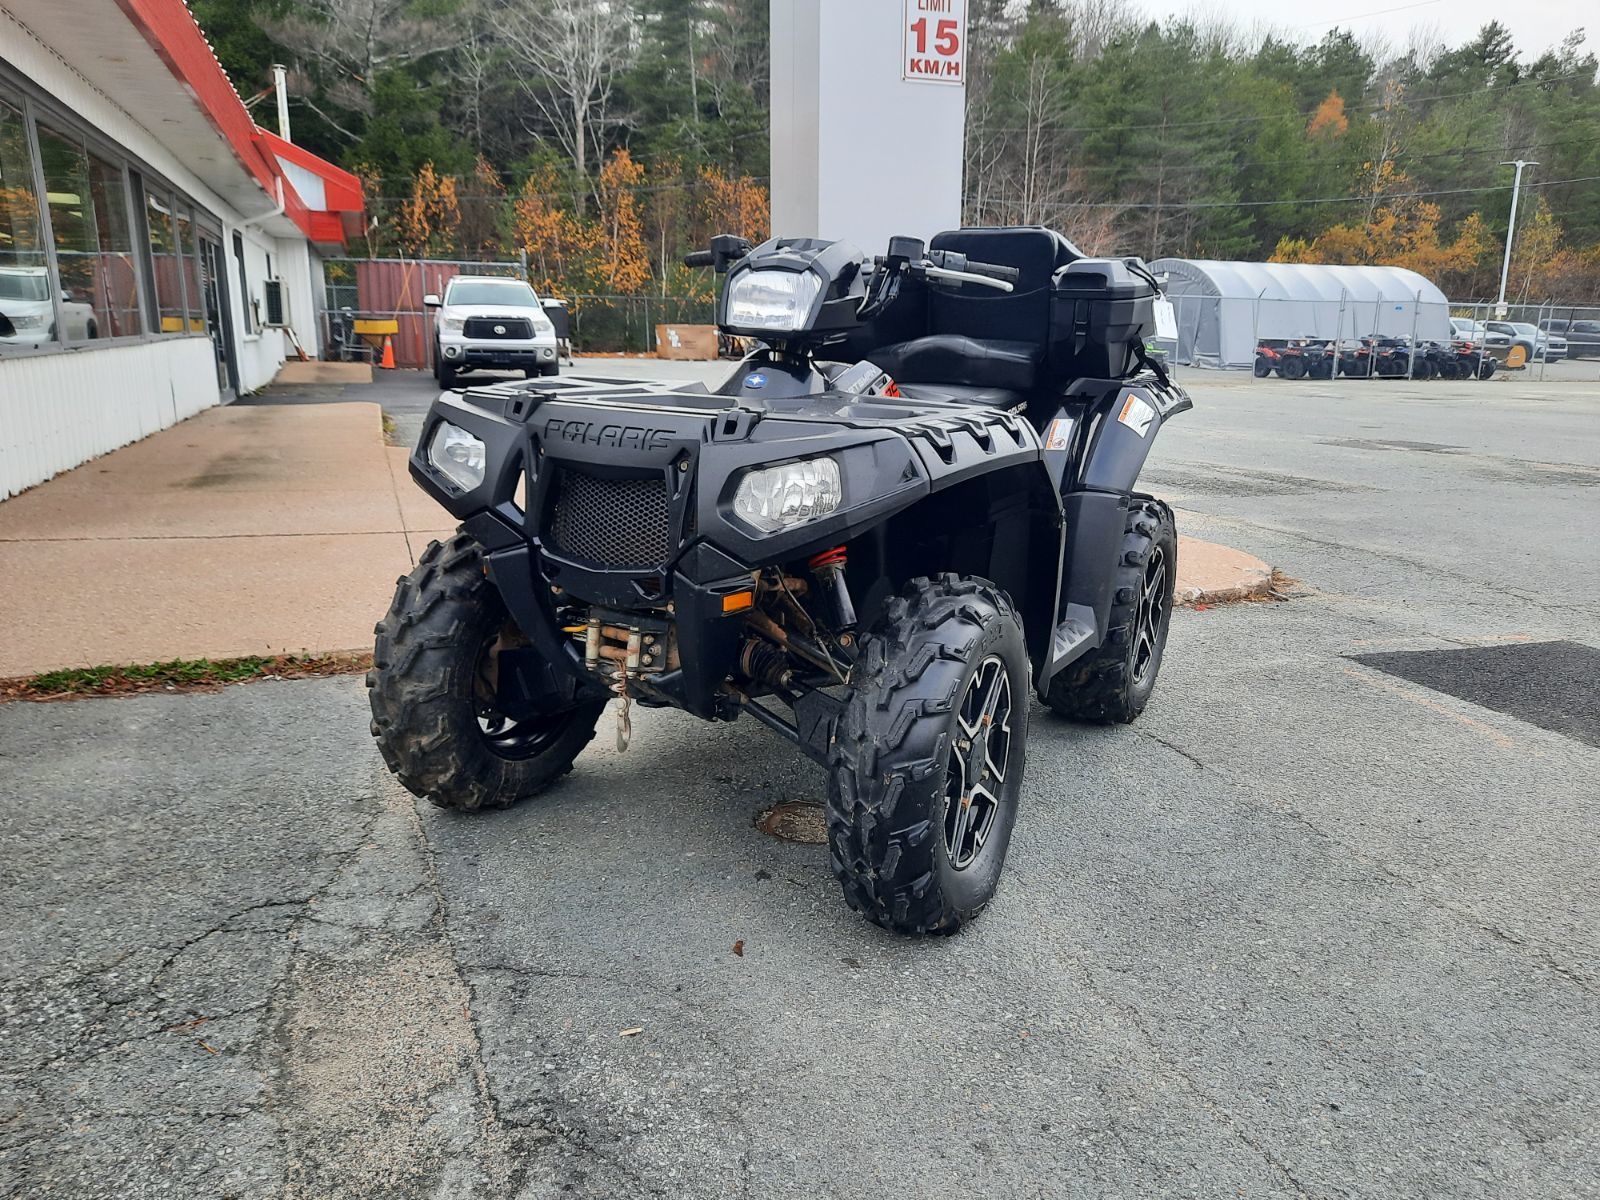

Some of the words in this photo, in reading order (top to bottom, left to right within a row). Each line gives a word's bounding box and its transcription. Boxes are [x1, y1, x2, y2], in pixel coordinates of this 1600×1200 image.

[911, 17, 959, 56] 15
[910, 58, 960, 76] KM/H
[544, 418, 677, 450] POLARIS
